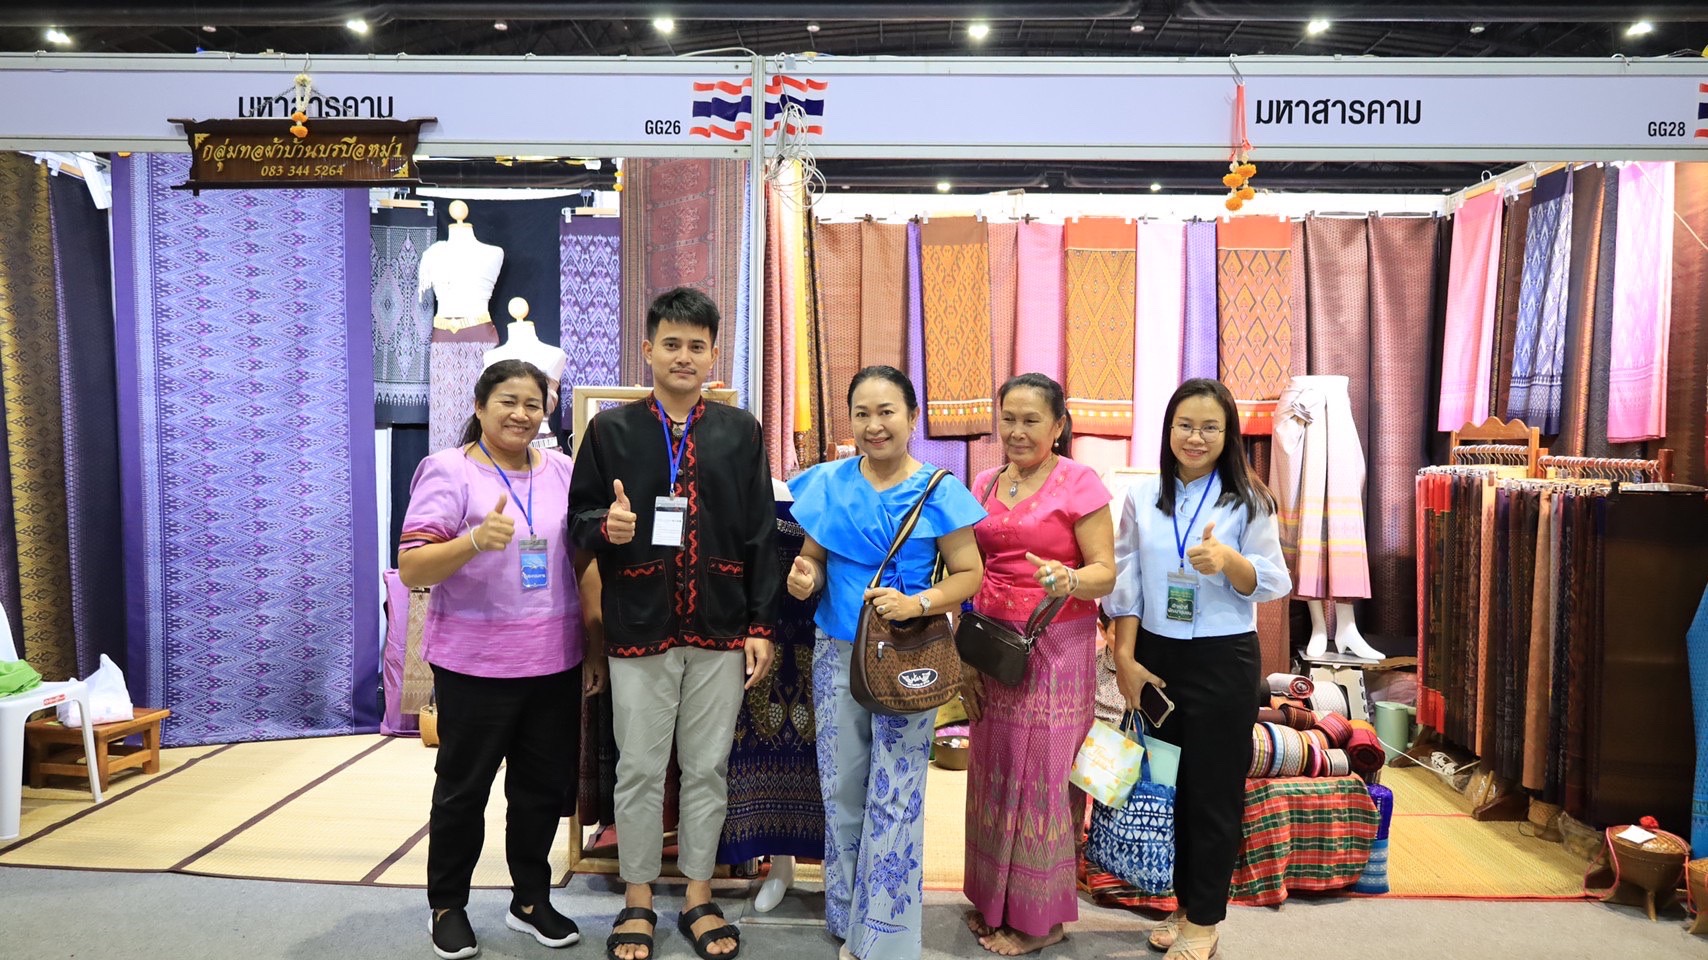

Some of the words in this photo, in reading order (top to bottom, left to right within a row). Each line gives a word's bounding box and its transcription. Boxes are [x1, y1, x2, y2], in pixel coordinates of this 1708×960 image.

[1255, 98, 1421, 125] มหาสารคาม
[645, 120, 681, 135] GG26
[1647, 121, 1686, 137] GG28
[260, 166, 284, 177] 083
[287, 166, 310, 177] 344
[313, 165, 344, 177] 5264
